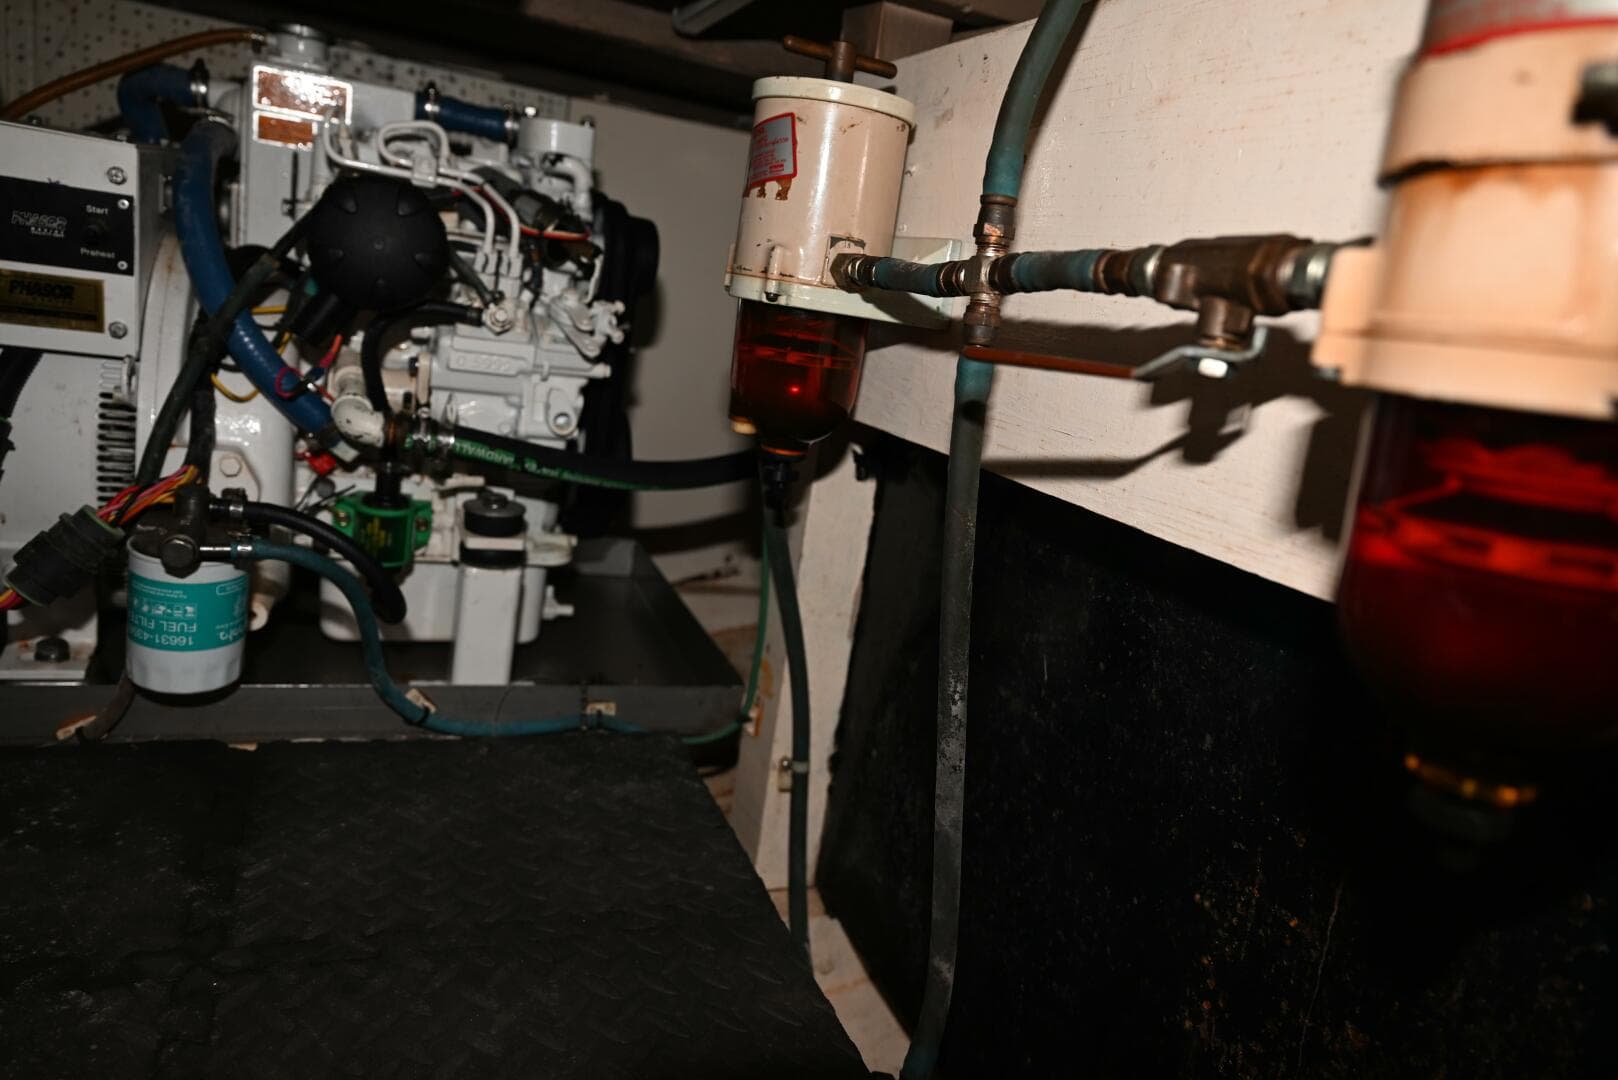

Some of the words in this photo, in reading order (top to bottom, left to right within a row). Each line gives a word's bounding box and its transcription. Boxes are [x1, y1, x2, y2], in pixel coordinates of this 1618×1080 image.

[85, 204, 109, 215] Start
[80, 247, 116, 259] Preheat
[160, 621, 198, 633] FUEL
